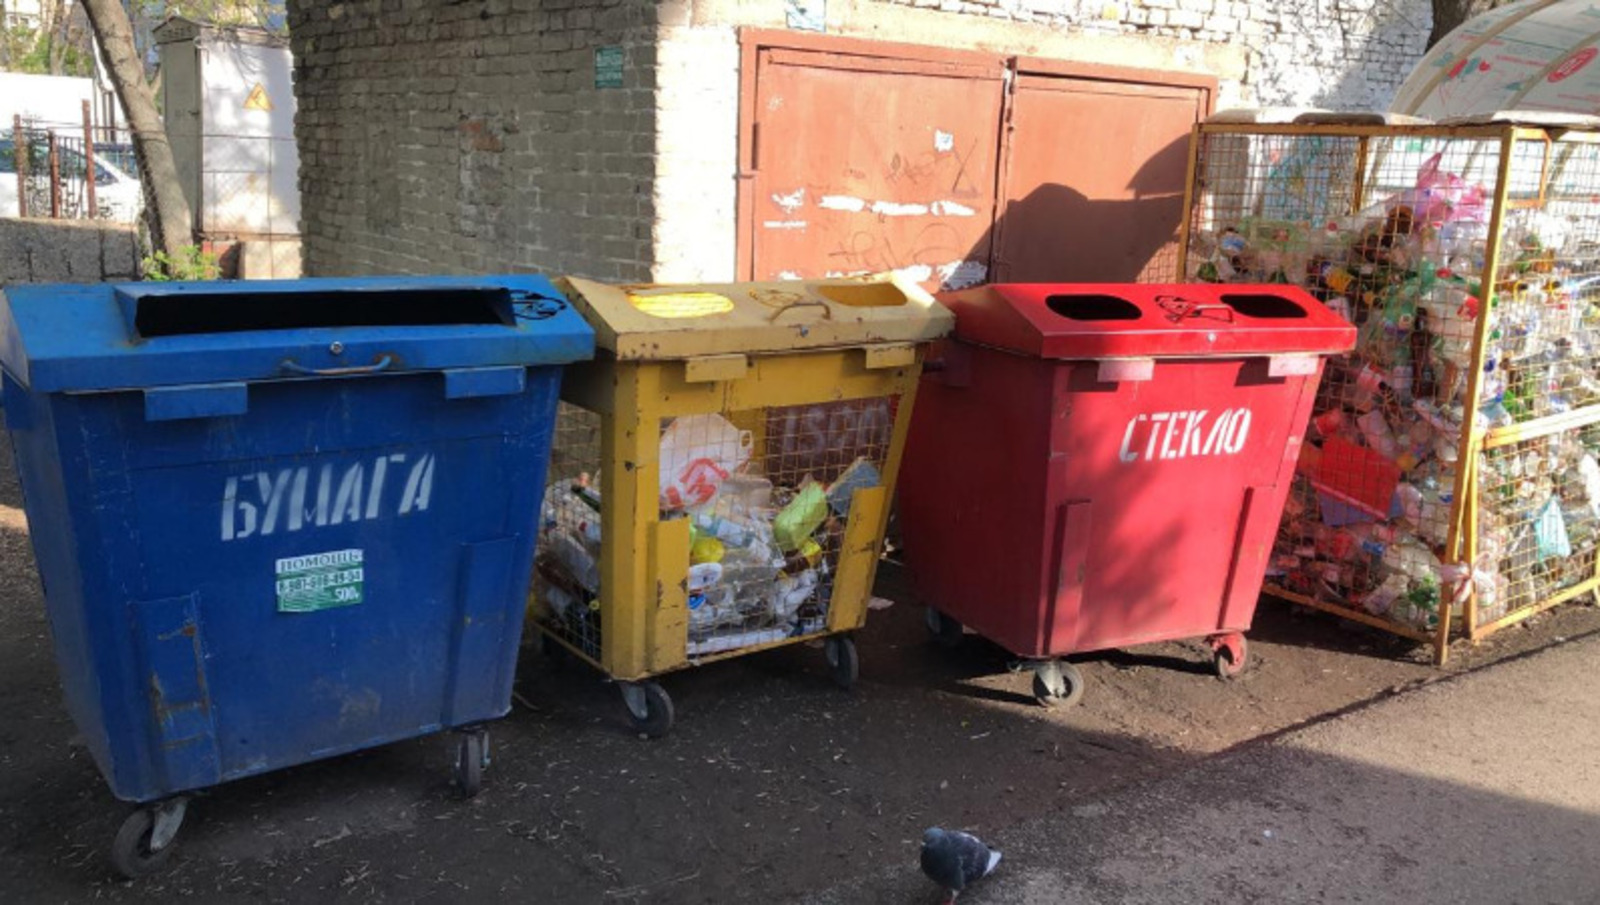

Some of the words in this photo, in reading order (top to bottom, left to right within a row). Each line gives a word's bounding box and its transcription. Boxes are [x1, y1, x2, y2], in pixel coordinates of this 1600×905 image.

[1119, 407, 1252, 463] СТЕКЛО
[220, 453, 436, 541] БУМАГА
[280, 551, 361, 572] ПОМОЩЬ
